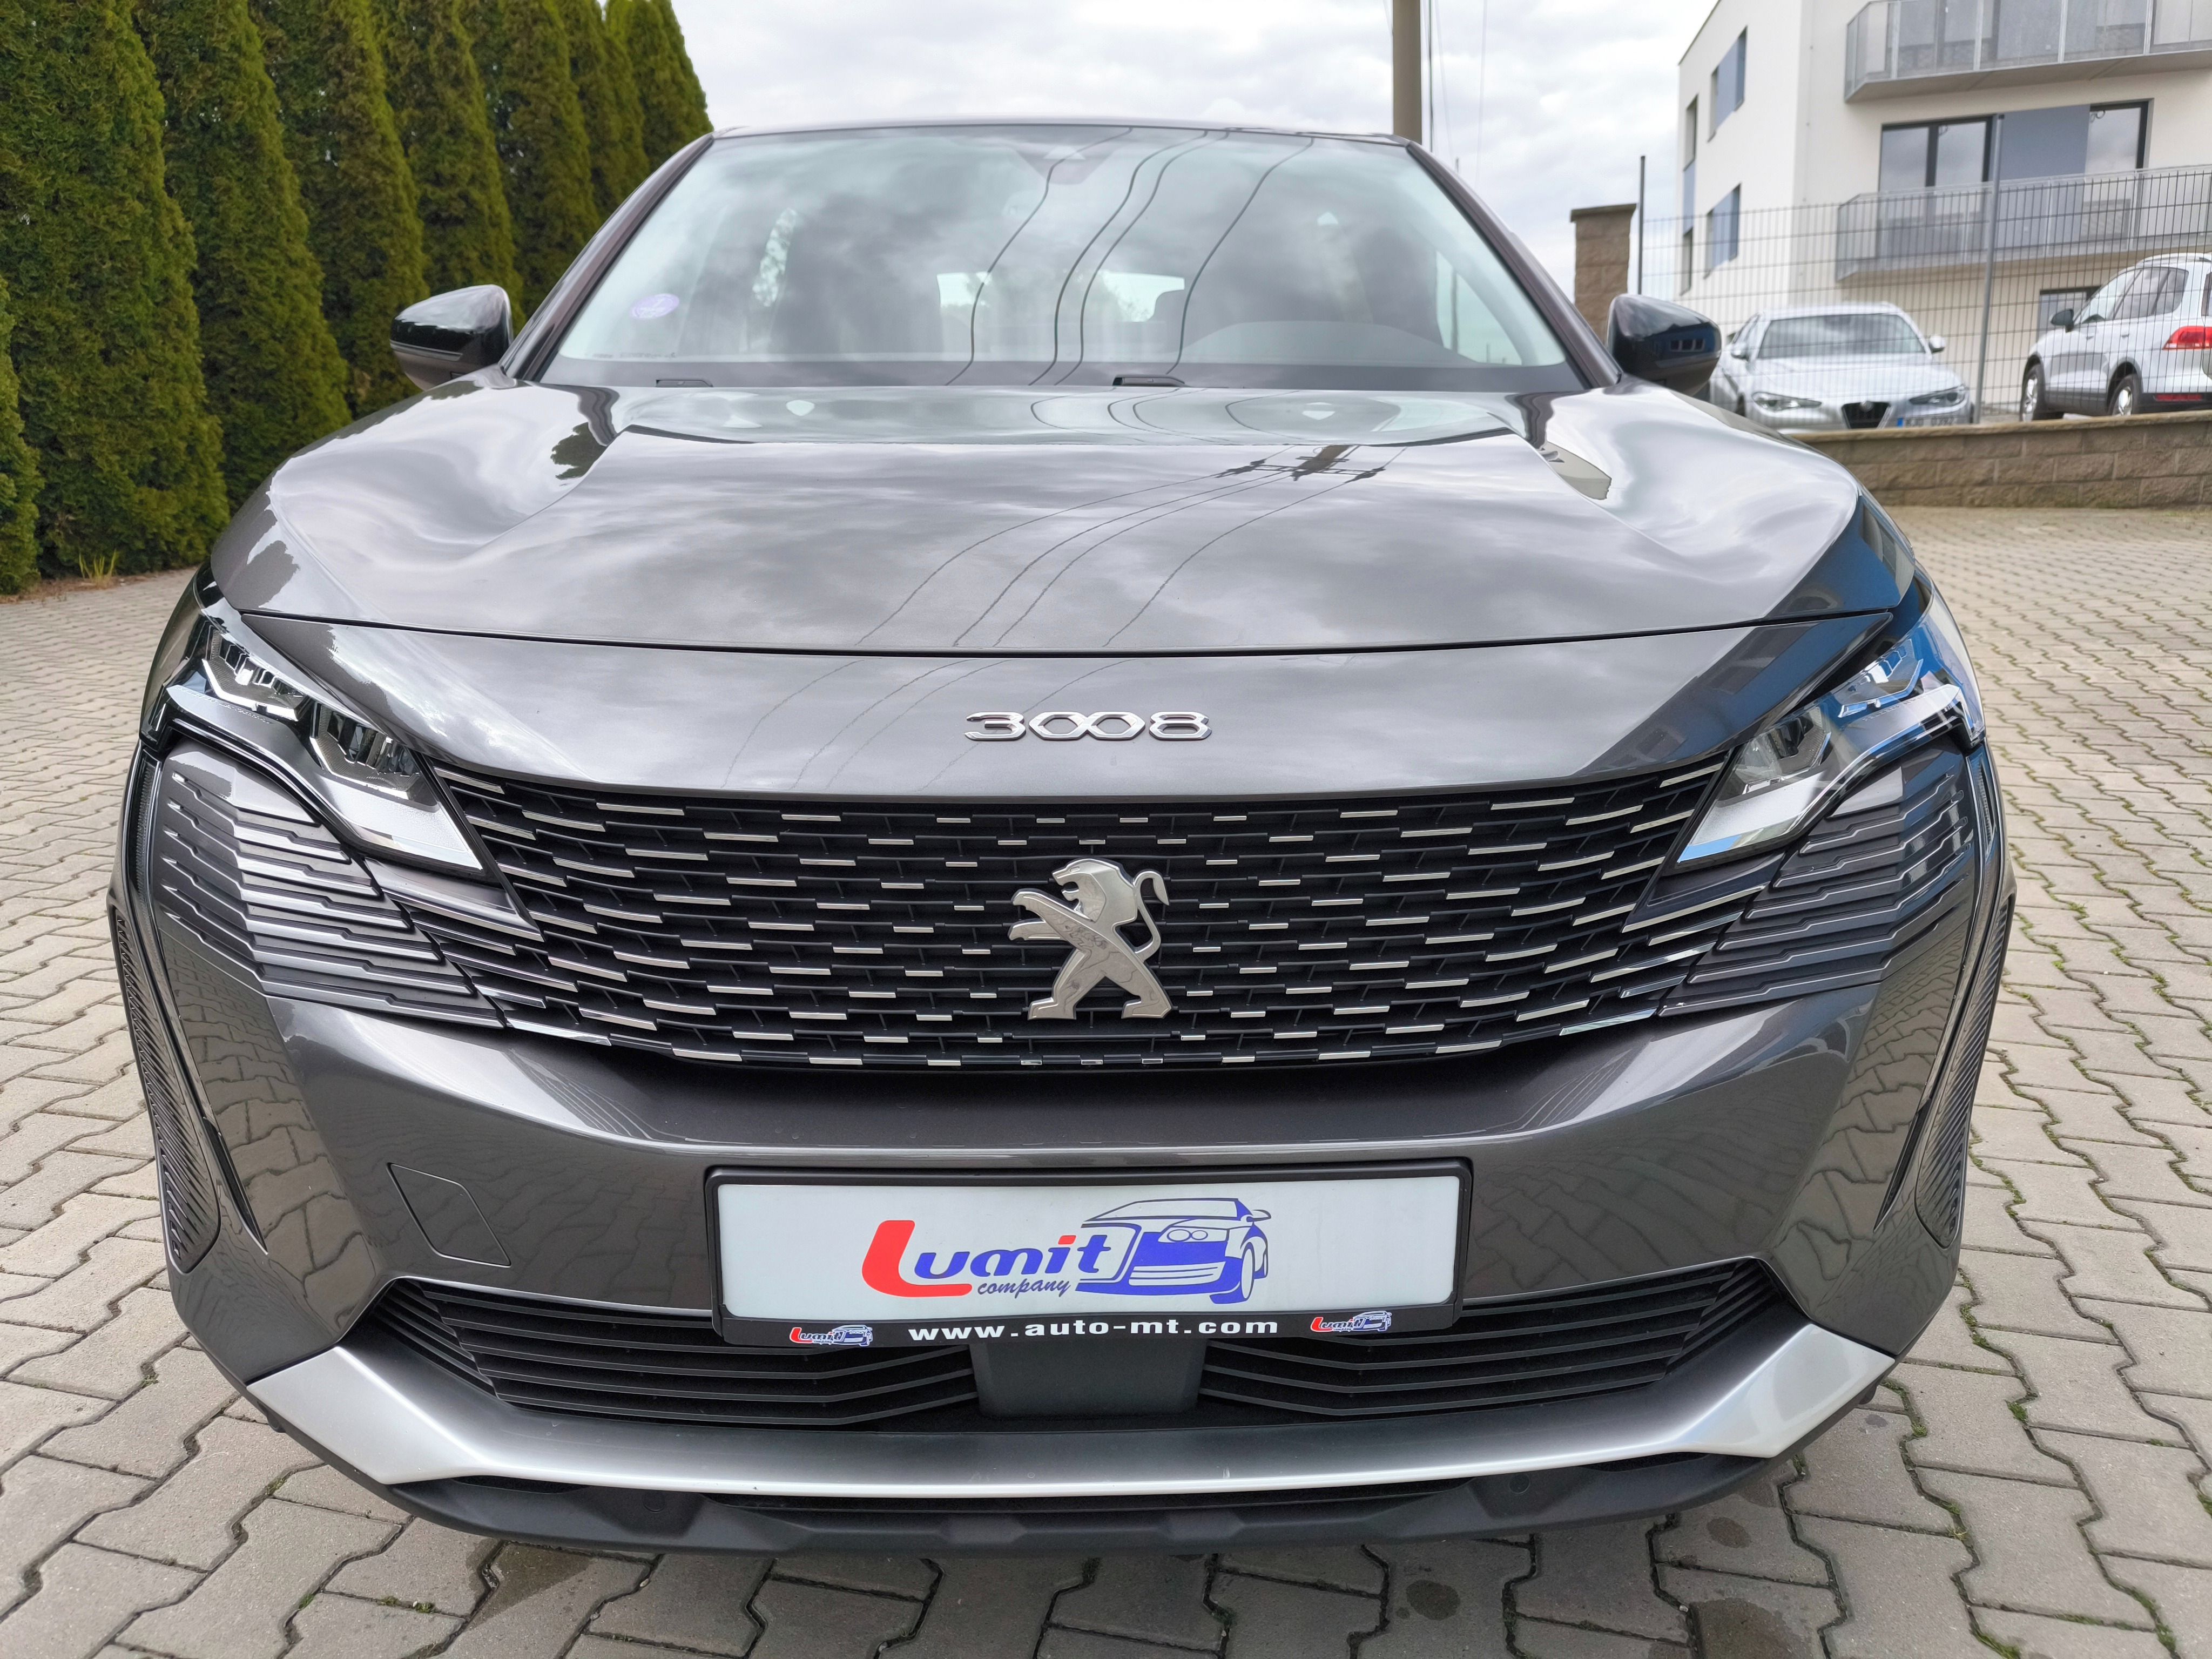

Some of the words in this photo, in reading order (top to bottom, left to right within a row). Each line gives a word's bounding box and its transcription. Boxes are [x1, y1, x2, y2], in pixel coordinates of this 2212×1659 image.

[963, 711, 1213, 740] 3008
[861, 1219, 1112, 1298] Lumit
[977, 1278, 1071, 1299] company
[790, 1327, 842, 1344] Lumit
[908, 1319, 1278, 1340] www.auto-mt.com
